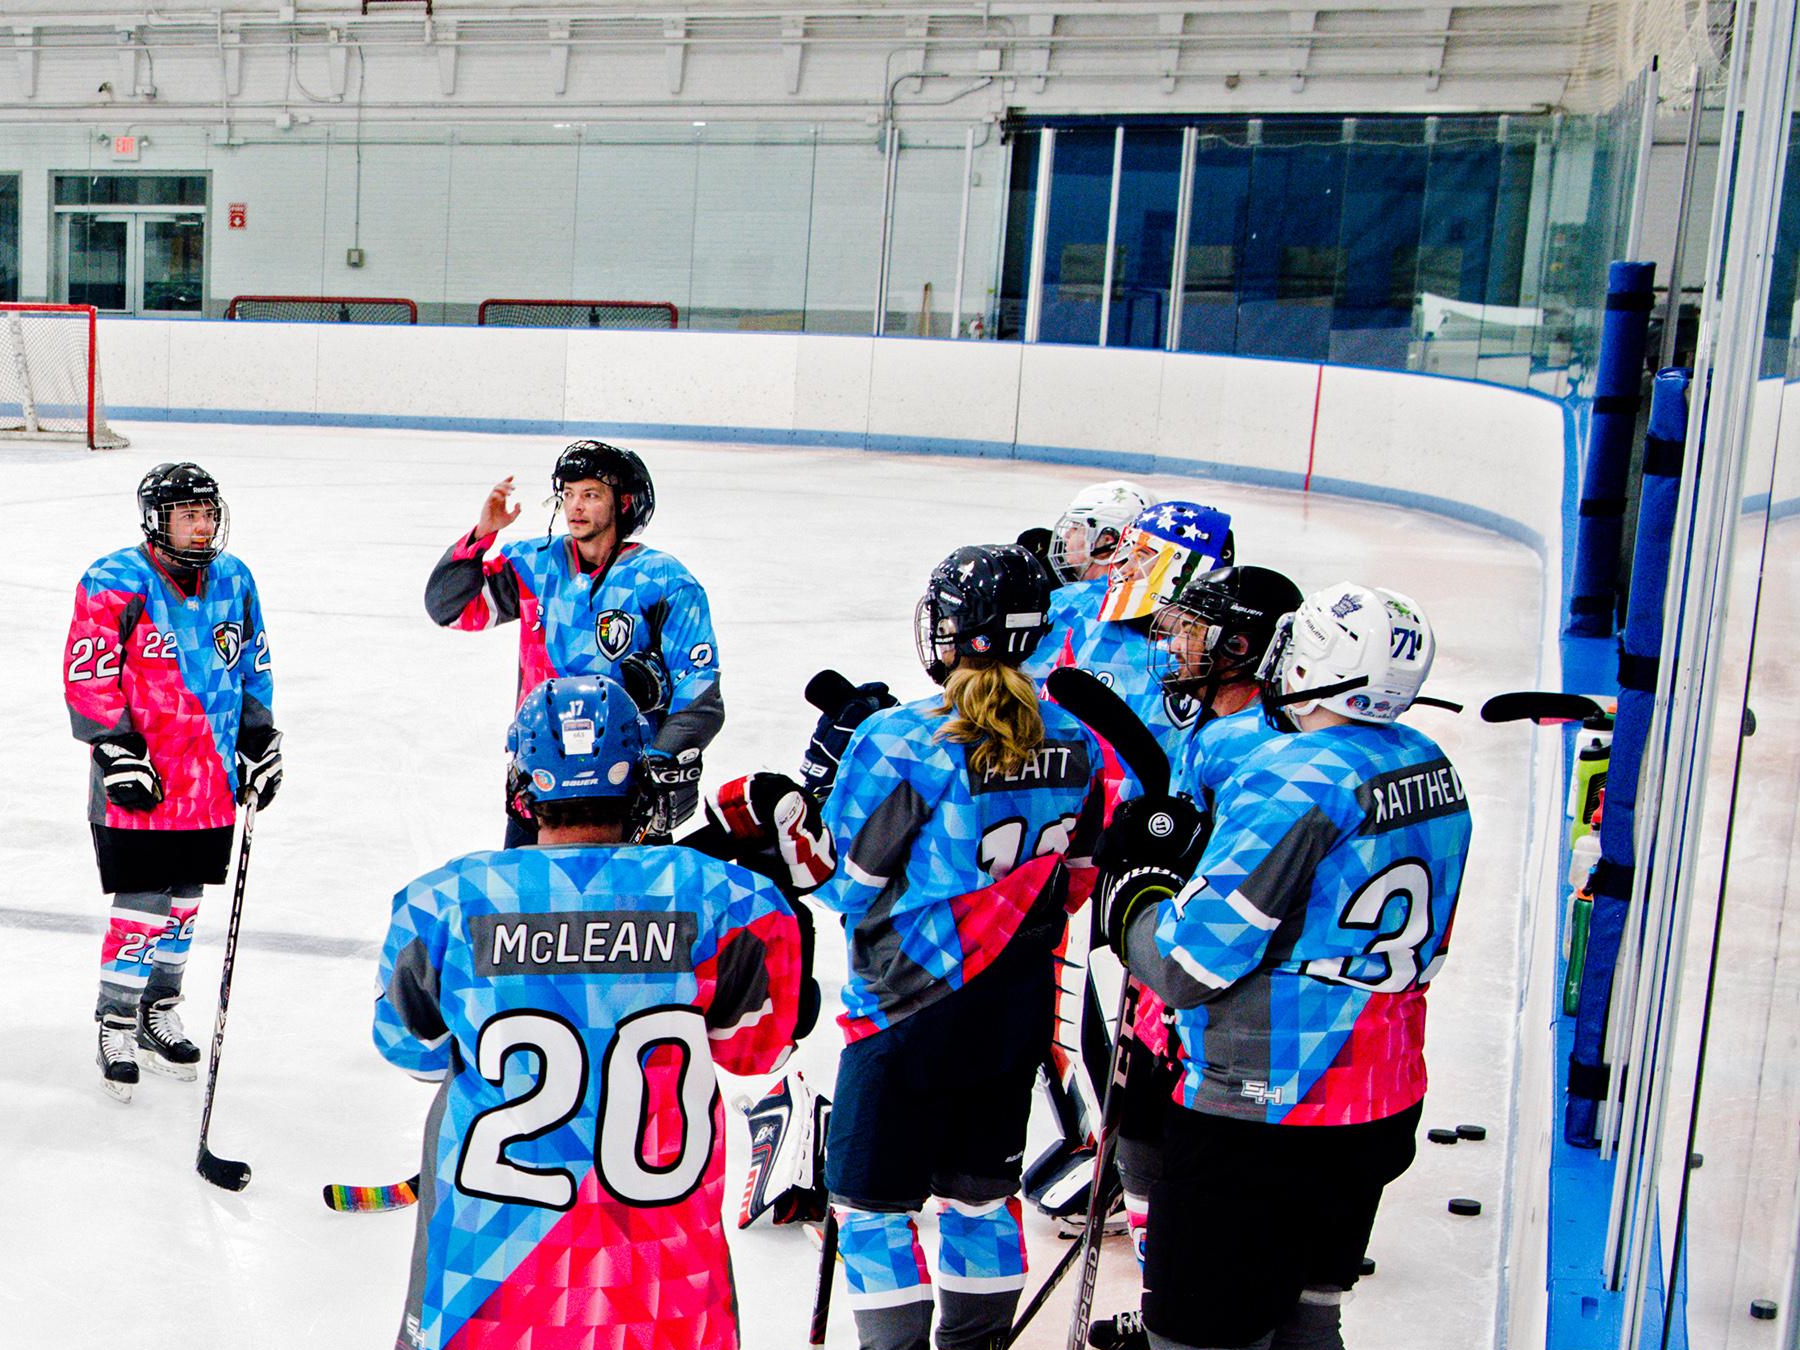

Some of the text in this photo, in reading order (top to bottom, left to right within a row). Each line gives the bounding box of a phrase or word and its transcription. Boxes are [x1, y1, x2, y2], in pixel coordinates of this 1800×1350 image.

[116, 137, 135, 153] EXIT
[142, 631, 178, 660] 22
[1391, 627, 1417, 661] 71
[68, 637, 120, 683] 22
[568, 699, 584, 717] 17
[562, 777, 599, 787] BAUER
[491, 921, 678, 966] McLEAN
[454, 1003, 720, 1213] 20
